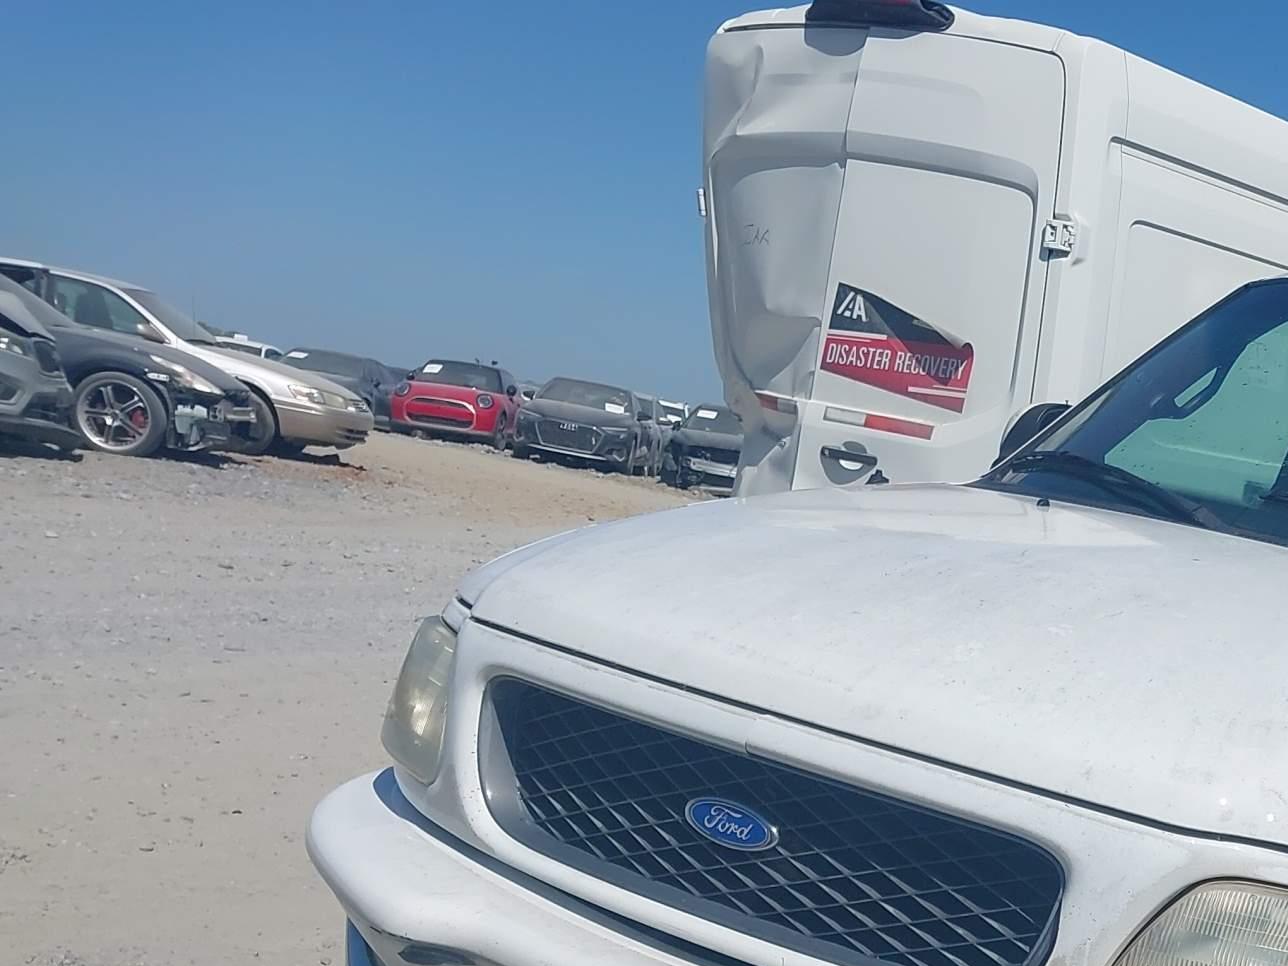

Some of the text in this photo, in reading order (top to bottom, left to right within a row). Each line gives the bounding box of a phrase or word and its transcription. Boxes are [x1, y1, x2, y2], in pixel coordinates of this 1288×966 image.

[826, 344, 967, 380] DISASTER RECOVERY
[704, 805, 754, 840] Ford
